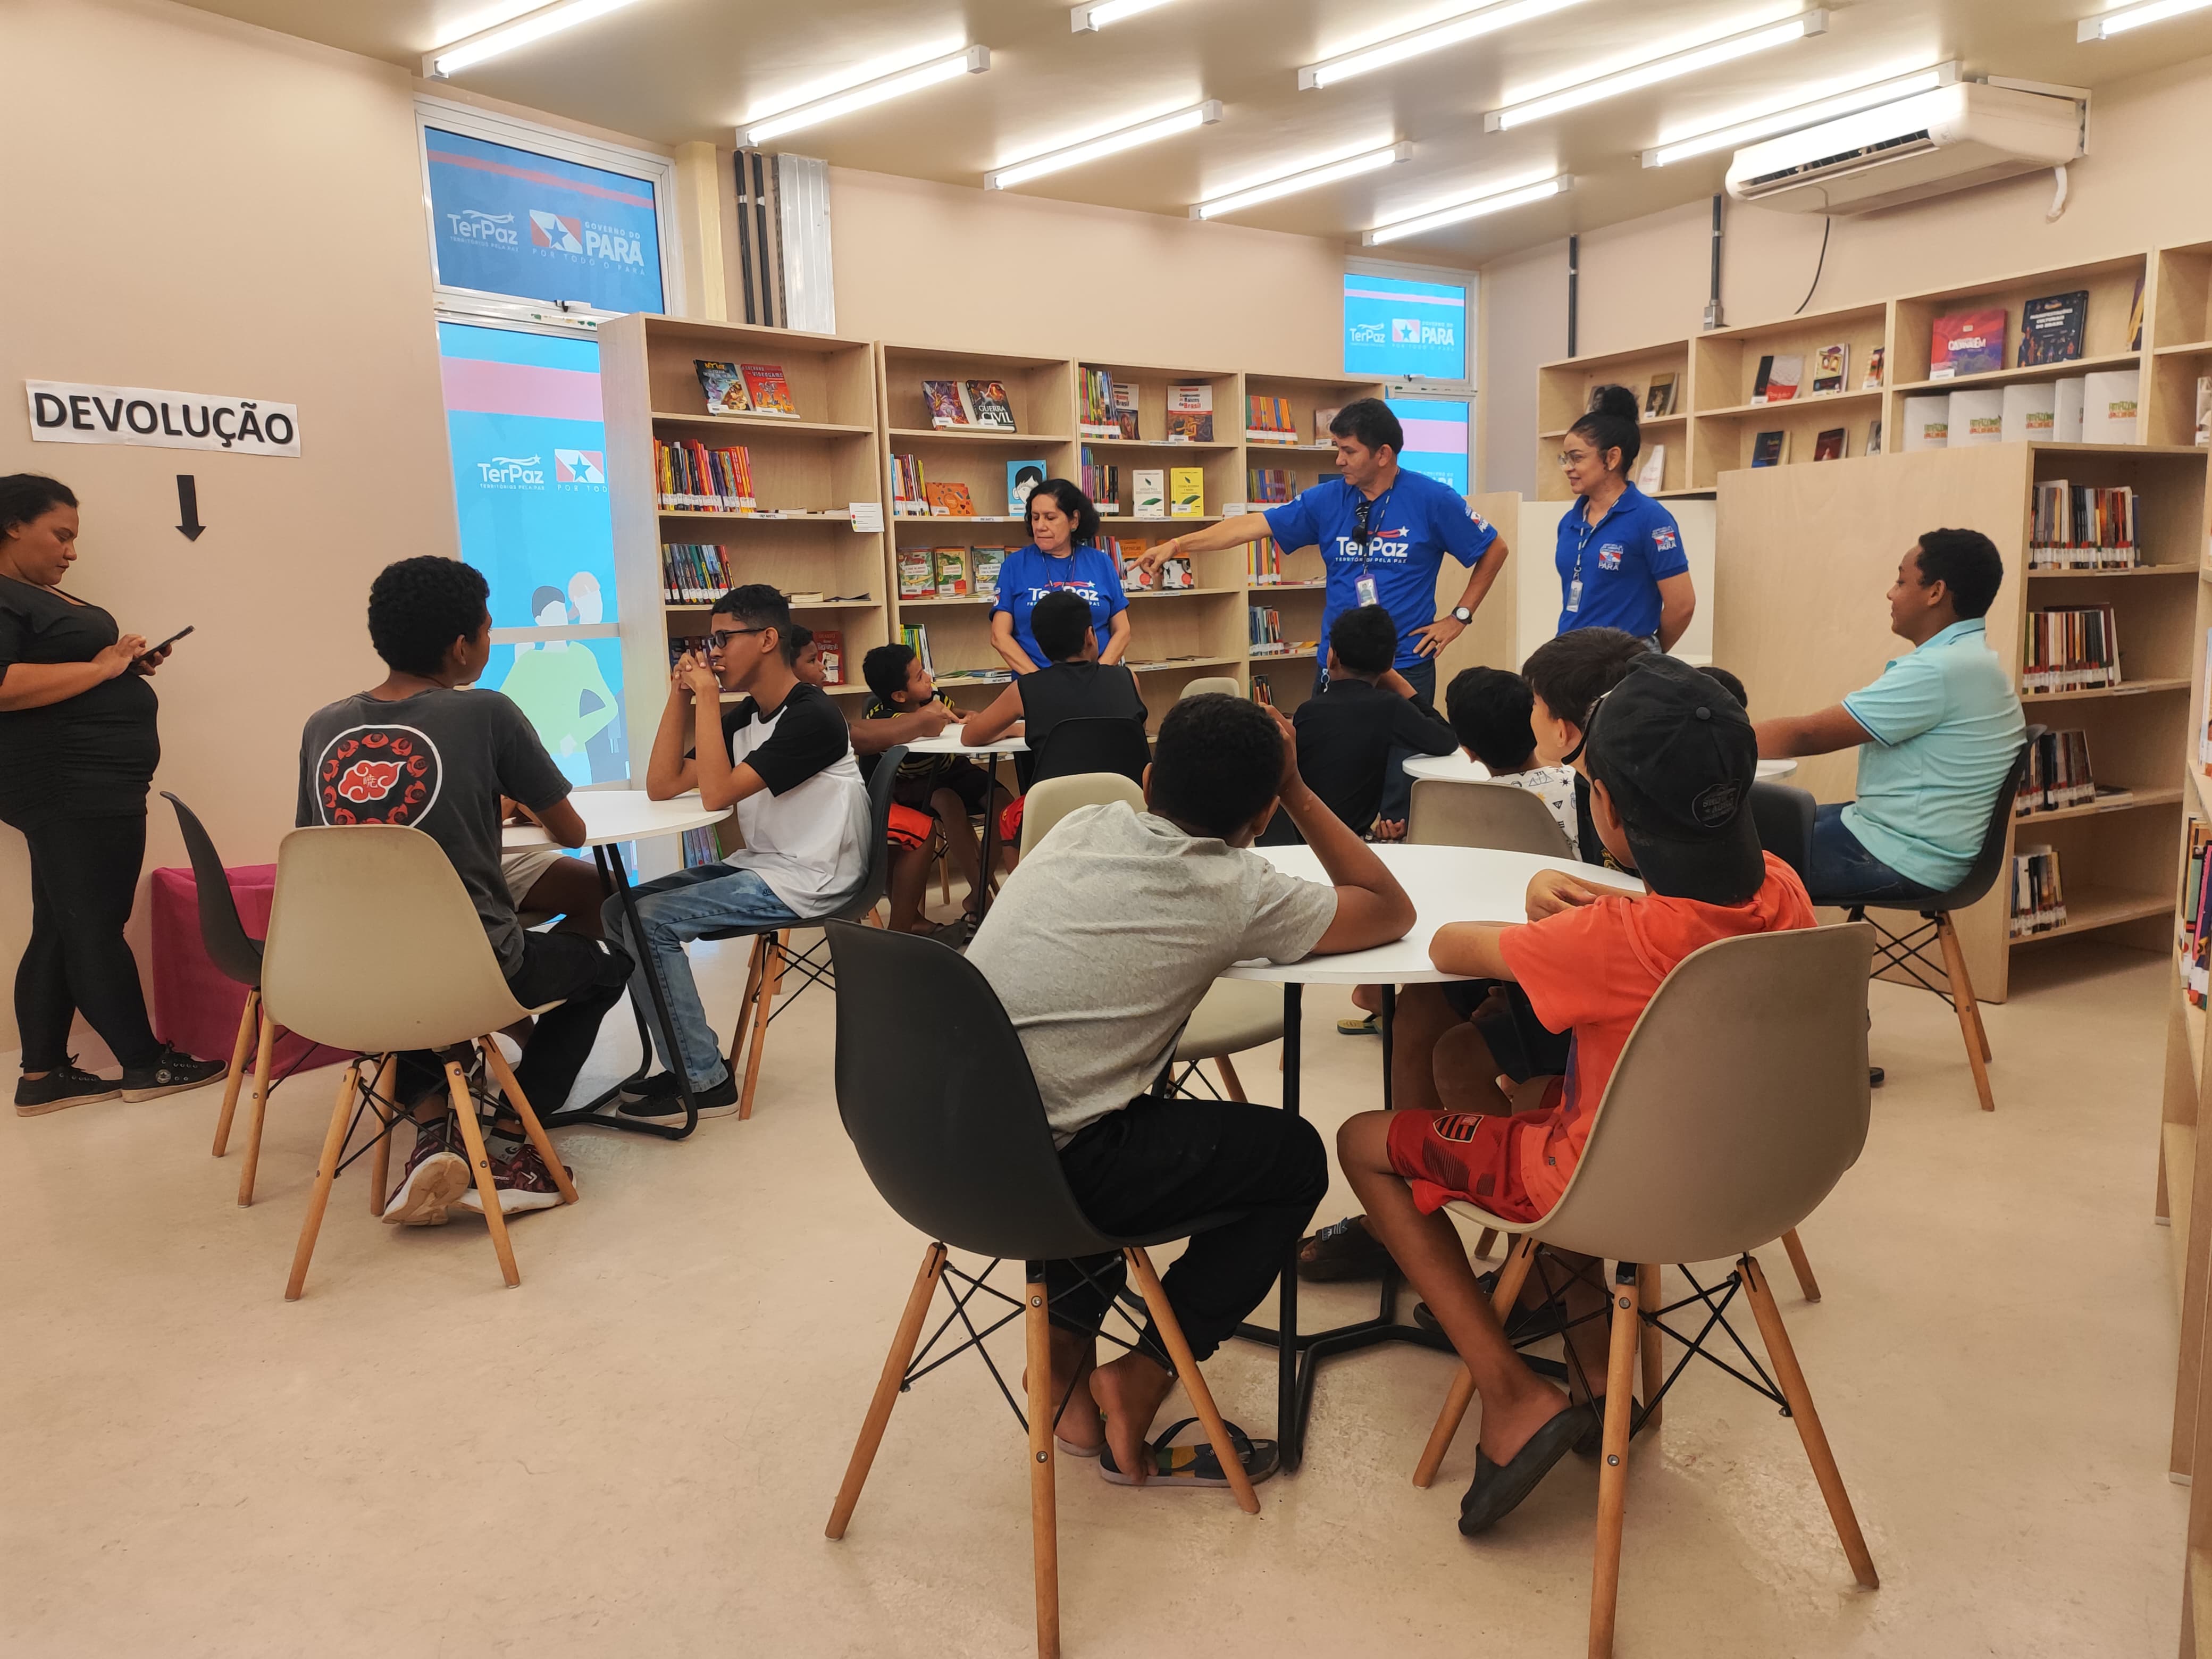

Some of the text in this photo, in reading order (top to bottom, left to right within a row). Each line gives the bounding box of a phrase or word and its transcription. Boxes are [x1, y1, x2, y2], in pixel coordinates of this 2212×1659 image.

[447, 213, 519, 245] TerPaz
[584, 221, 625, 237] GOVERNO
[532, 248, 555, 258] POR
[563, 253, 595, 266] TODO
[1349, 328, 1386, 343] TerPaz
[34, 392, 294, 448] DEVOLUÇÃO
[982, 412, 1014, 423] CIVIL
[477, 463, 544, 484] TerPaz
[363, 774, 378, 788] 暁
